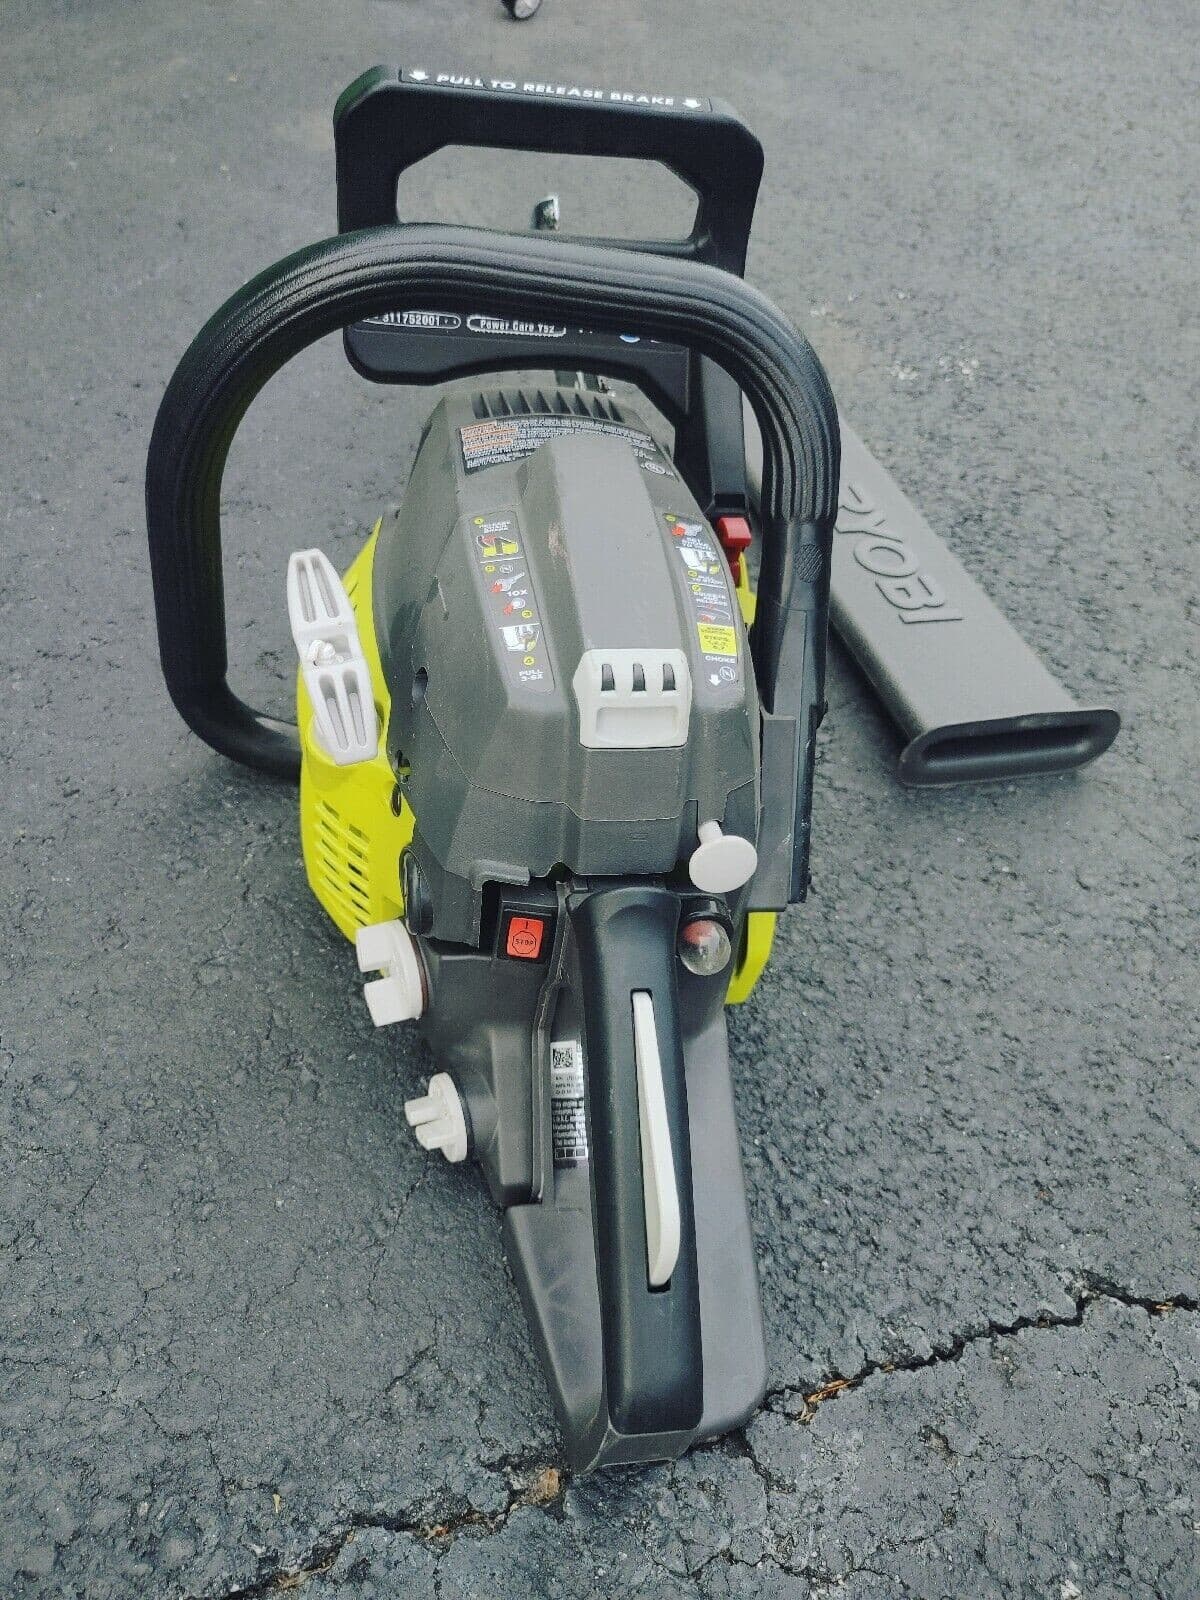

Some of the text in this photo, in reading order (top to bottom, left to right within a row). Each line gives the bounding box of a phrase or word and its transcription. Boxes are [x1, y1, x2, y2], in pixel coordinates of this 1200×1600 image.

[436, 73, 675, 106] PULL TO RELEASE BRAKE
[480, 319, 509, 331] Power
[512, 320, 535, 332] Care
[705, 655, 736, 663] CHOKE
[515, 938, 534, 946] STOP
